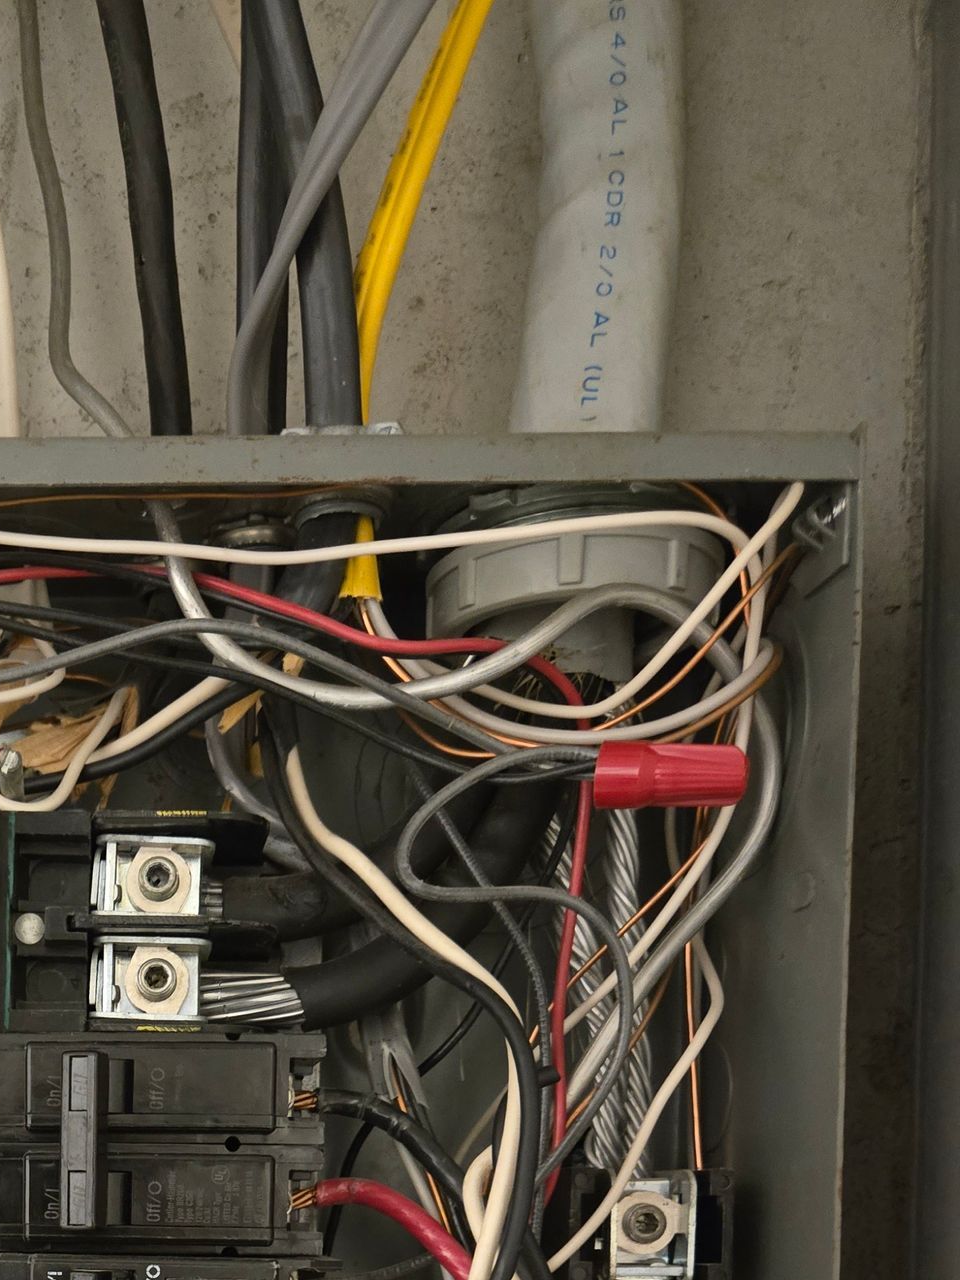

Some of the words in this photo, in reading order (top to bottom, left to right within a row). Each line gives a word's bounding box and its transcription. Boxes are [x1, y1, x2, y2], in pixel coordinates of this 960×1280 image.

[608, 0, 626, 22] S
[609, 34, 627, 87] 4/0
[611, 99, 629, 135] AL
[589, 311, 610, 348] AL
